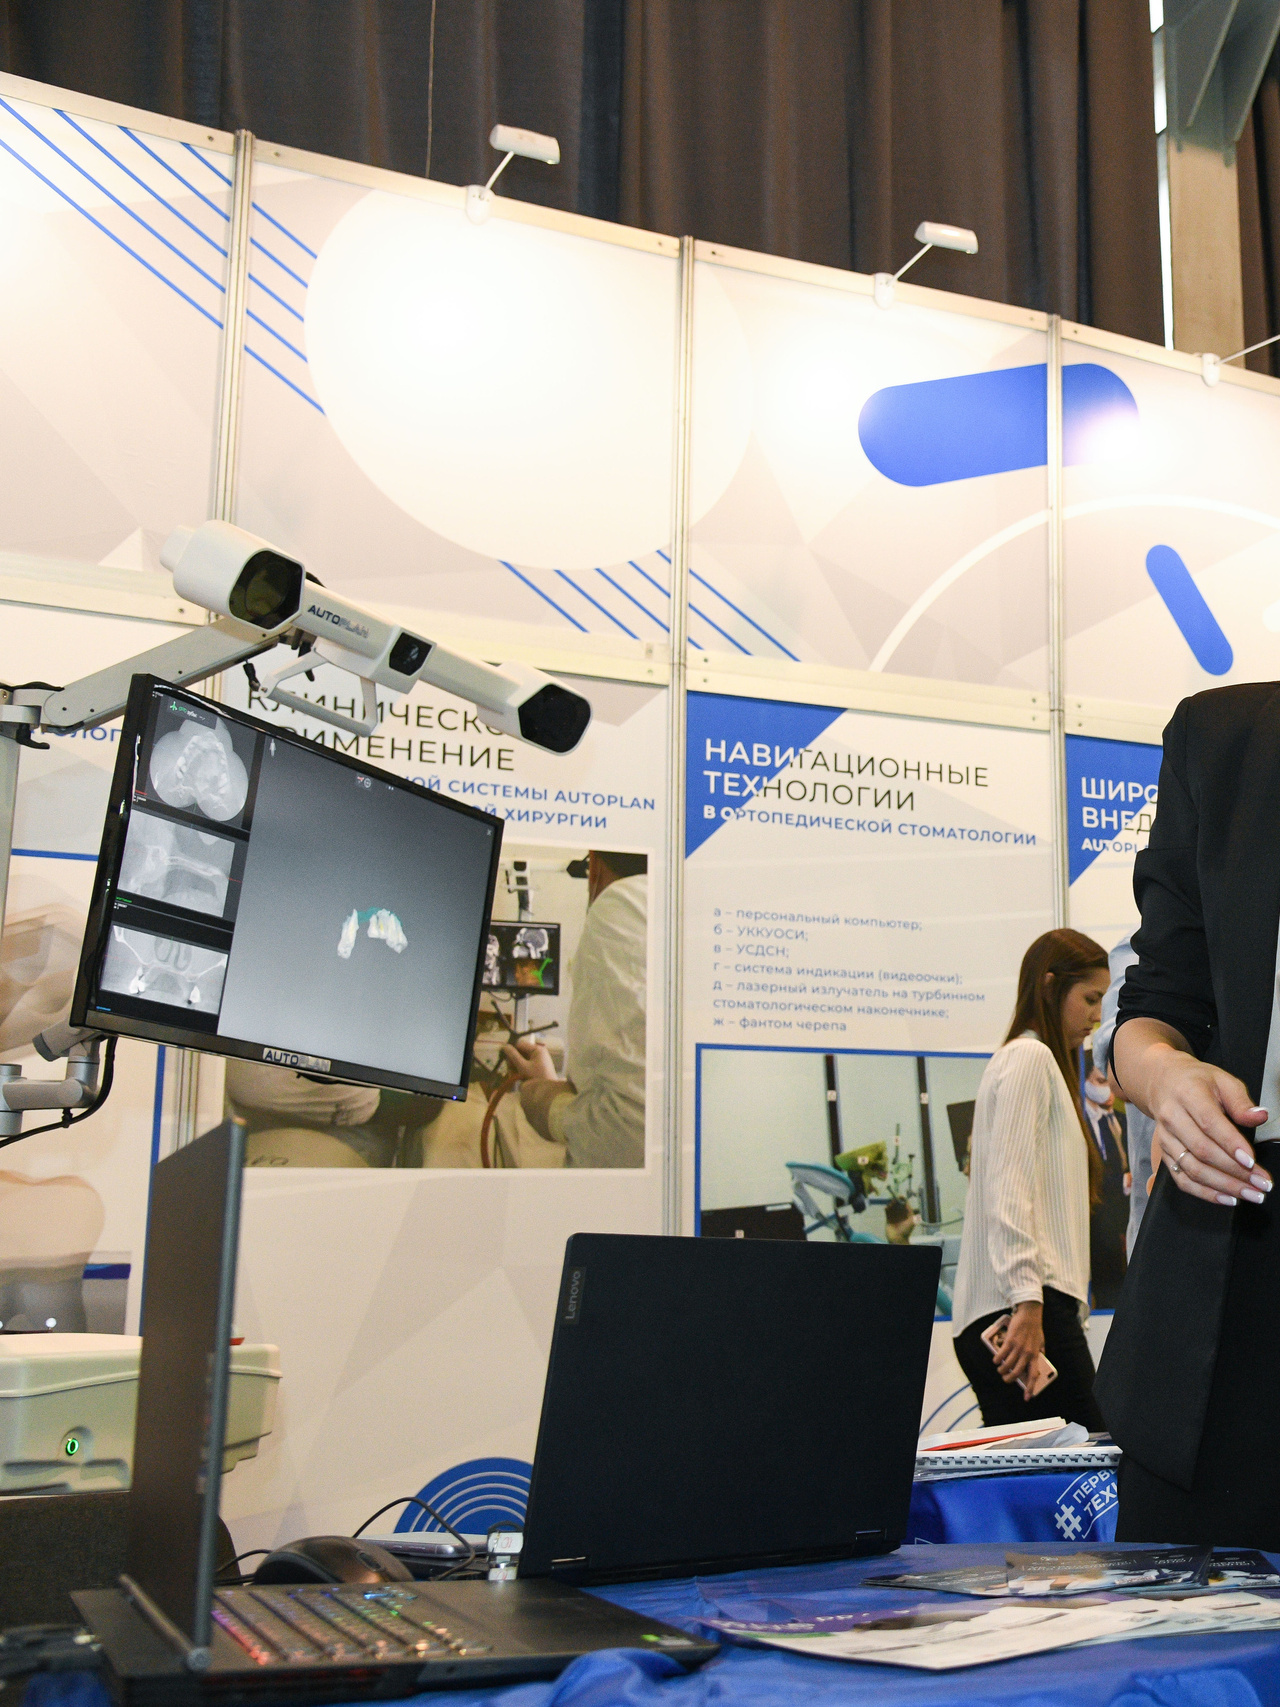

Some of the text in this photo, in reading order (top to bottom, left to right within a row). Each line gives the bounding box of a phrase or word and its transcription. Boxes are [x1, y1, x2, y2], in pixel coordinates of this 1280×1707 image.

[280, 727, 514, 771] ИМЕНЕНИЕ
[705, 738, 989, 787] НАВИГАЦИОННЫЕ
[448, 779, 548, 801] СИСТЕМЫ
[554, 789, 656, 811] AUTOPLAN
[703, 770, 914, 811] ТЕХНОЛОГИИ
[1081, 776, 1158, 804] ШИРО
[505, 807, 607, 829] ХИРУРГИИ
[703, 805, 1036, 846] В ОРТОПЕДИЧЕСКОЙ СТОМАТОЛОГИИ
[713, 908, 721, 917] а
[736, 909, 840, 925] персональный
[844, 917, 923, 932] компьютер;
[713, 923, 723, 935] б
[737, 926, 808, 941] УККУОСИ;
[713, 944, 721, 953] в
[736, 944, 789, 958] УСДСН;
[713, 962, 720, 971] г
[734, 963, 792, 975] система
[797, 967, 874, 980] индикации
[713, 981, 722, 991] д
[736, 981, 807, 994] лазерный
[812, 985, 889, 998] излучатель
[892, 989, 908, 999] на
[912, 989, 985, 1002] турбинном
[713, 999, 949, 1019] стоматологическом наконечнике;
[713, 1017, 724, 1026] ж
[739, 1016, 792, 1029] фантом
[796, 1020, 847, 1031] черепа
[565, 1271, 581, 1320] Lenovo
